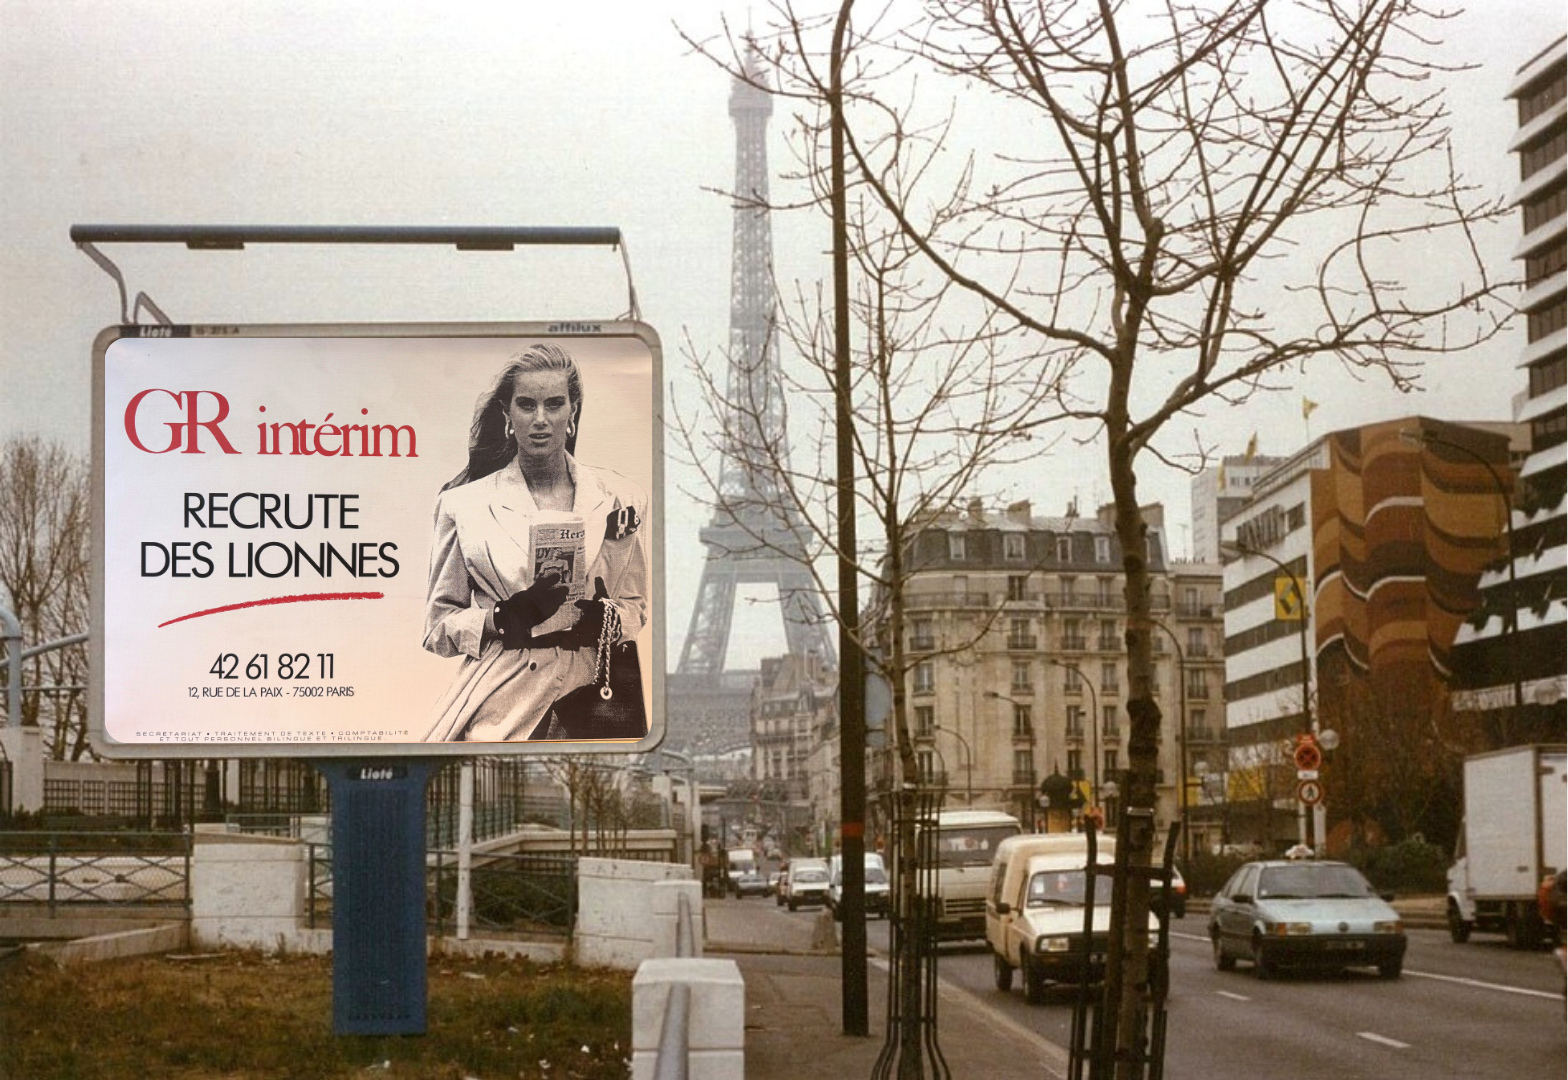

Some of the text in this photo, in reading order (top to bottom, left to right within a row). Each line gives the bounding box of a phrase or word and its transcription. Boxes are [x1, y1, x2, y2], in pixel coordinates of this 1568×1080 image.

[124, 388, 420, 458] GR intérim
[183, 492, 360, 530] RECRUTE
[140, 540, 400, 579] DES LIONNES
[209, 652, 334, 680] 42 61 82 11
[188, 687, 200, 699] 12,
[202, 687, 224, 698] RUE
[226, 687, 241, 698] DE
[243, 687, 258, 698] LA
[260, 687, 283, 698] PAIX
[293, 687, 324, 698] 75002
[326, 686, 355, 697] PARIS
